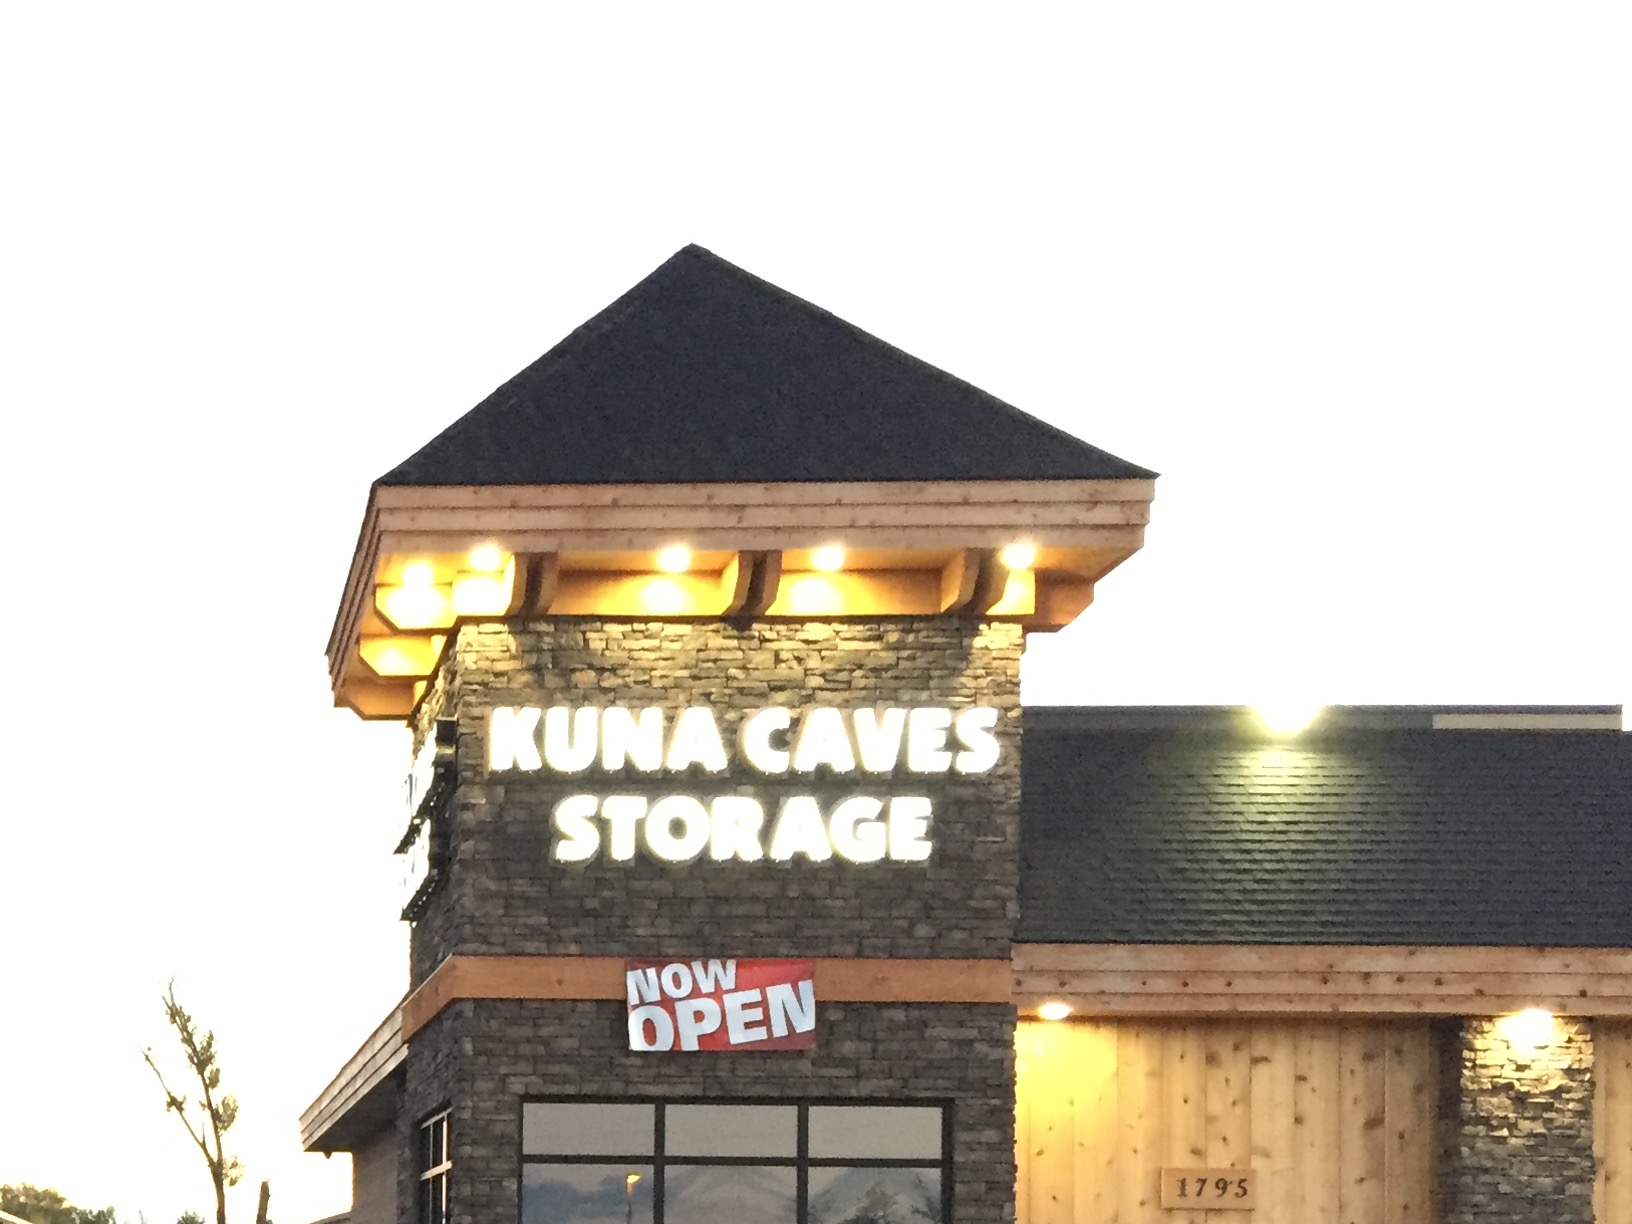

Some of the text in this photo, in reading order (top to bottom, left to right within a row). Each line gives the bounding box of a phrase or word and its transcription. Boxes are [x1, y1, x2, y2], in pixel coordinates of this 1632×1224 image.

[488, 706, 1000, 775] KUNA CAVES
[554, 794, 933, 863] STORAGE
[626, 958, 737, 1006] NOW
[627, 979, 816, 1051] OPEN
[1176, 1177, 1248, 1199] 1795
